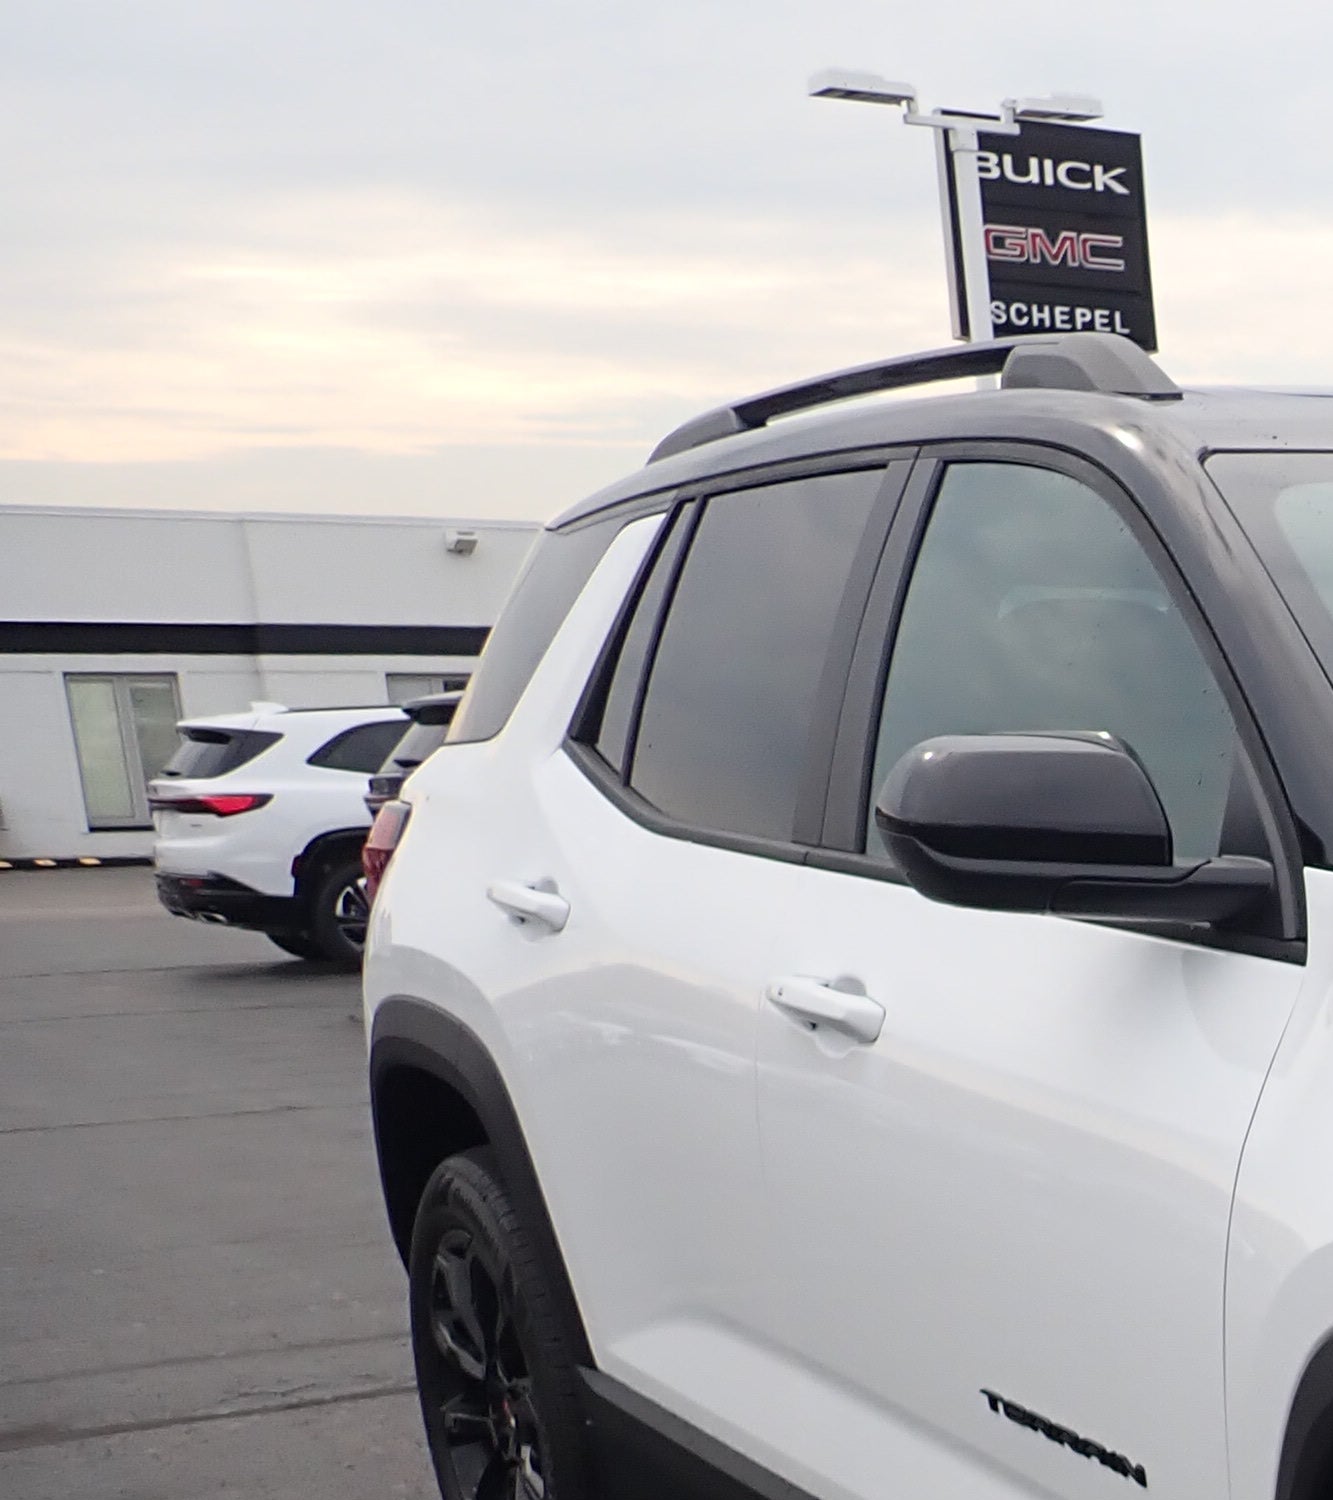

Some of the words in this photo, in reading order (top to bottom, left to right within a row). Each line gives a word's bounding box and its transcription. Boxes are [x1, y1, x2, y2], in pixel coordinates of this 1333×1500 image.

[976, 151, 1130, 196] BUICK
[983, 223, 1126, 272] GMC
[990, 301, 1131, 335] SCHEPEL
